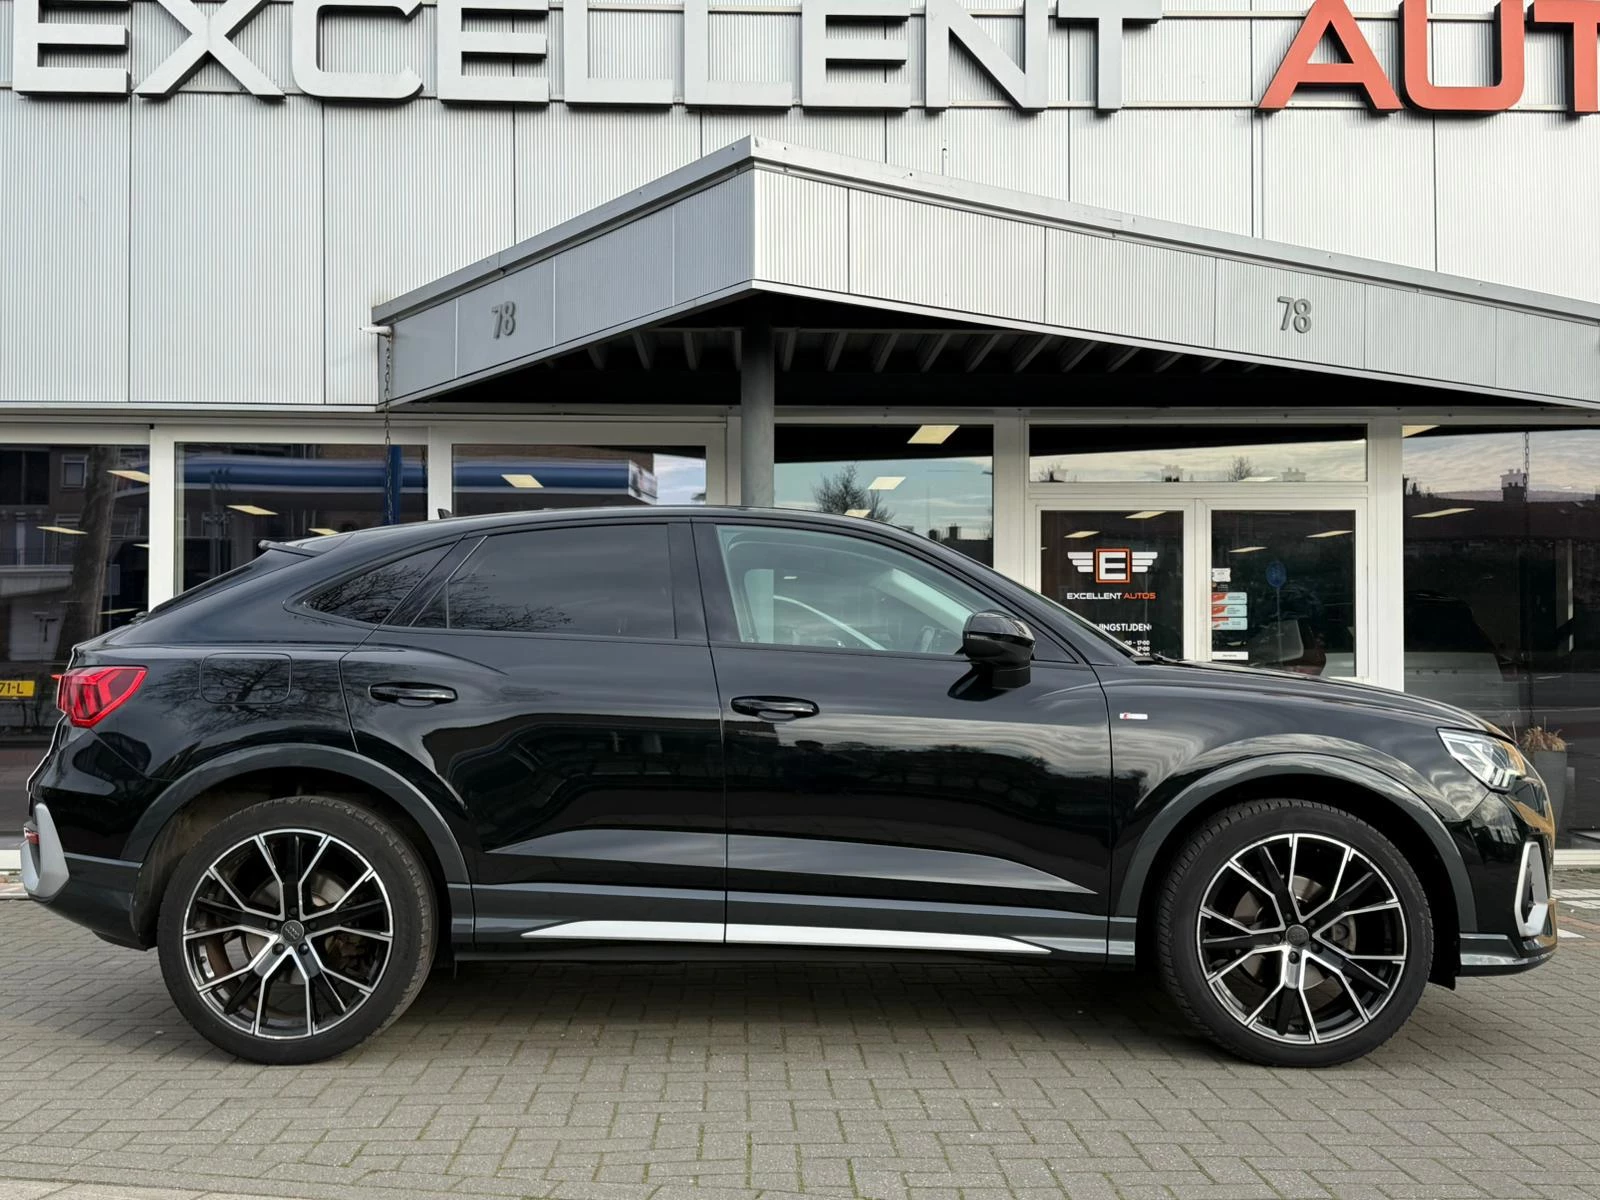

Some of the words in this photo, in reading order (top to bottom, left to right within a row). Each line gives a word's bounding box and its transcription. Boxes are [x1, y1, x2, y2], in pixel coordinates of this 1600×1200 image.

[12, 0, 1161, 111] EXCELLENT
[491, 301, 516, 340] 78
[1277, 296, 1311, 334] 78
[1066, 592, 1122, 600] EXCELLENT
[1123, 592, 1156, 600] AUTOS
